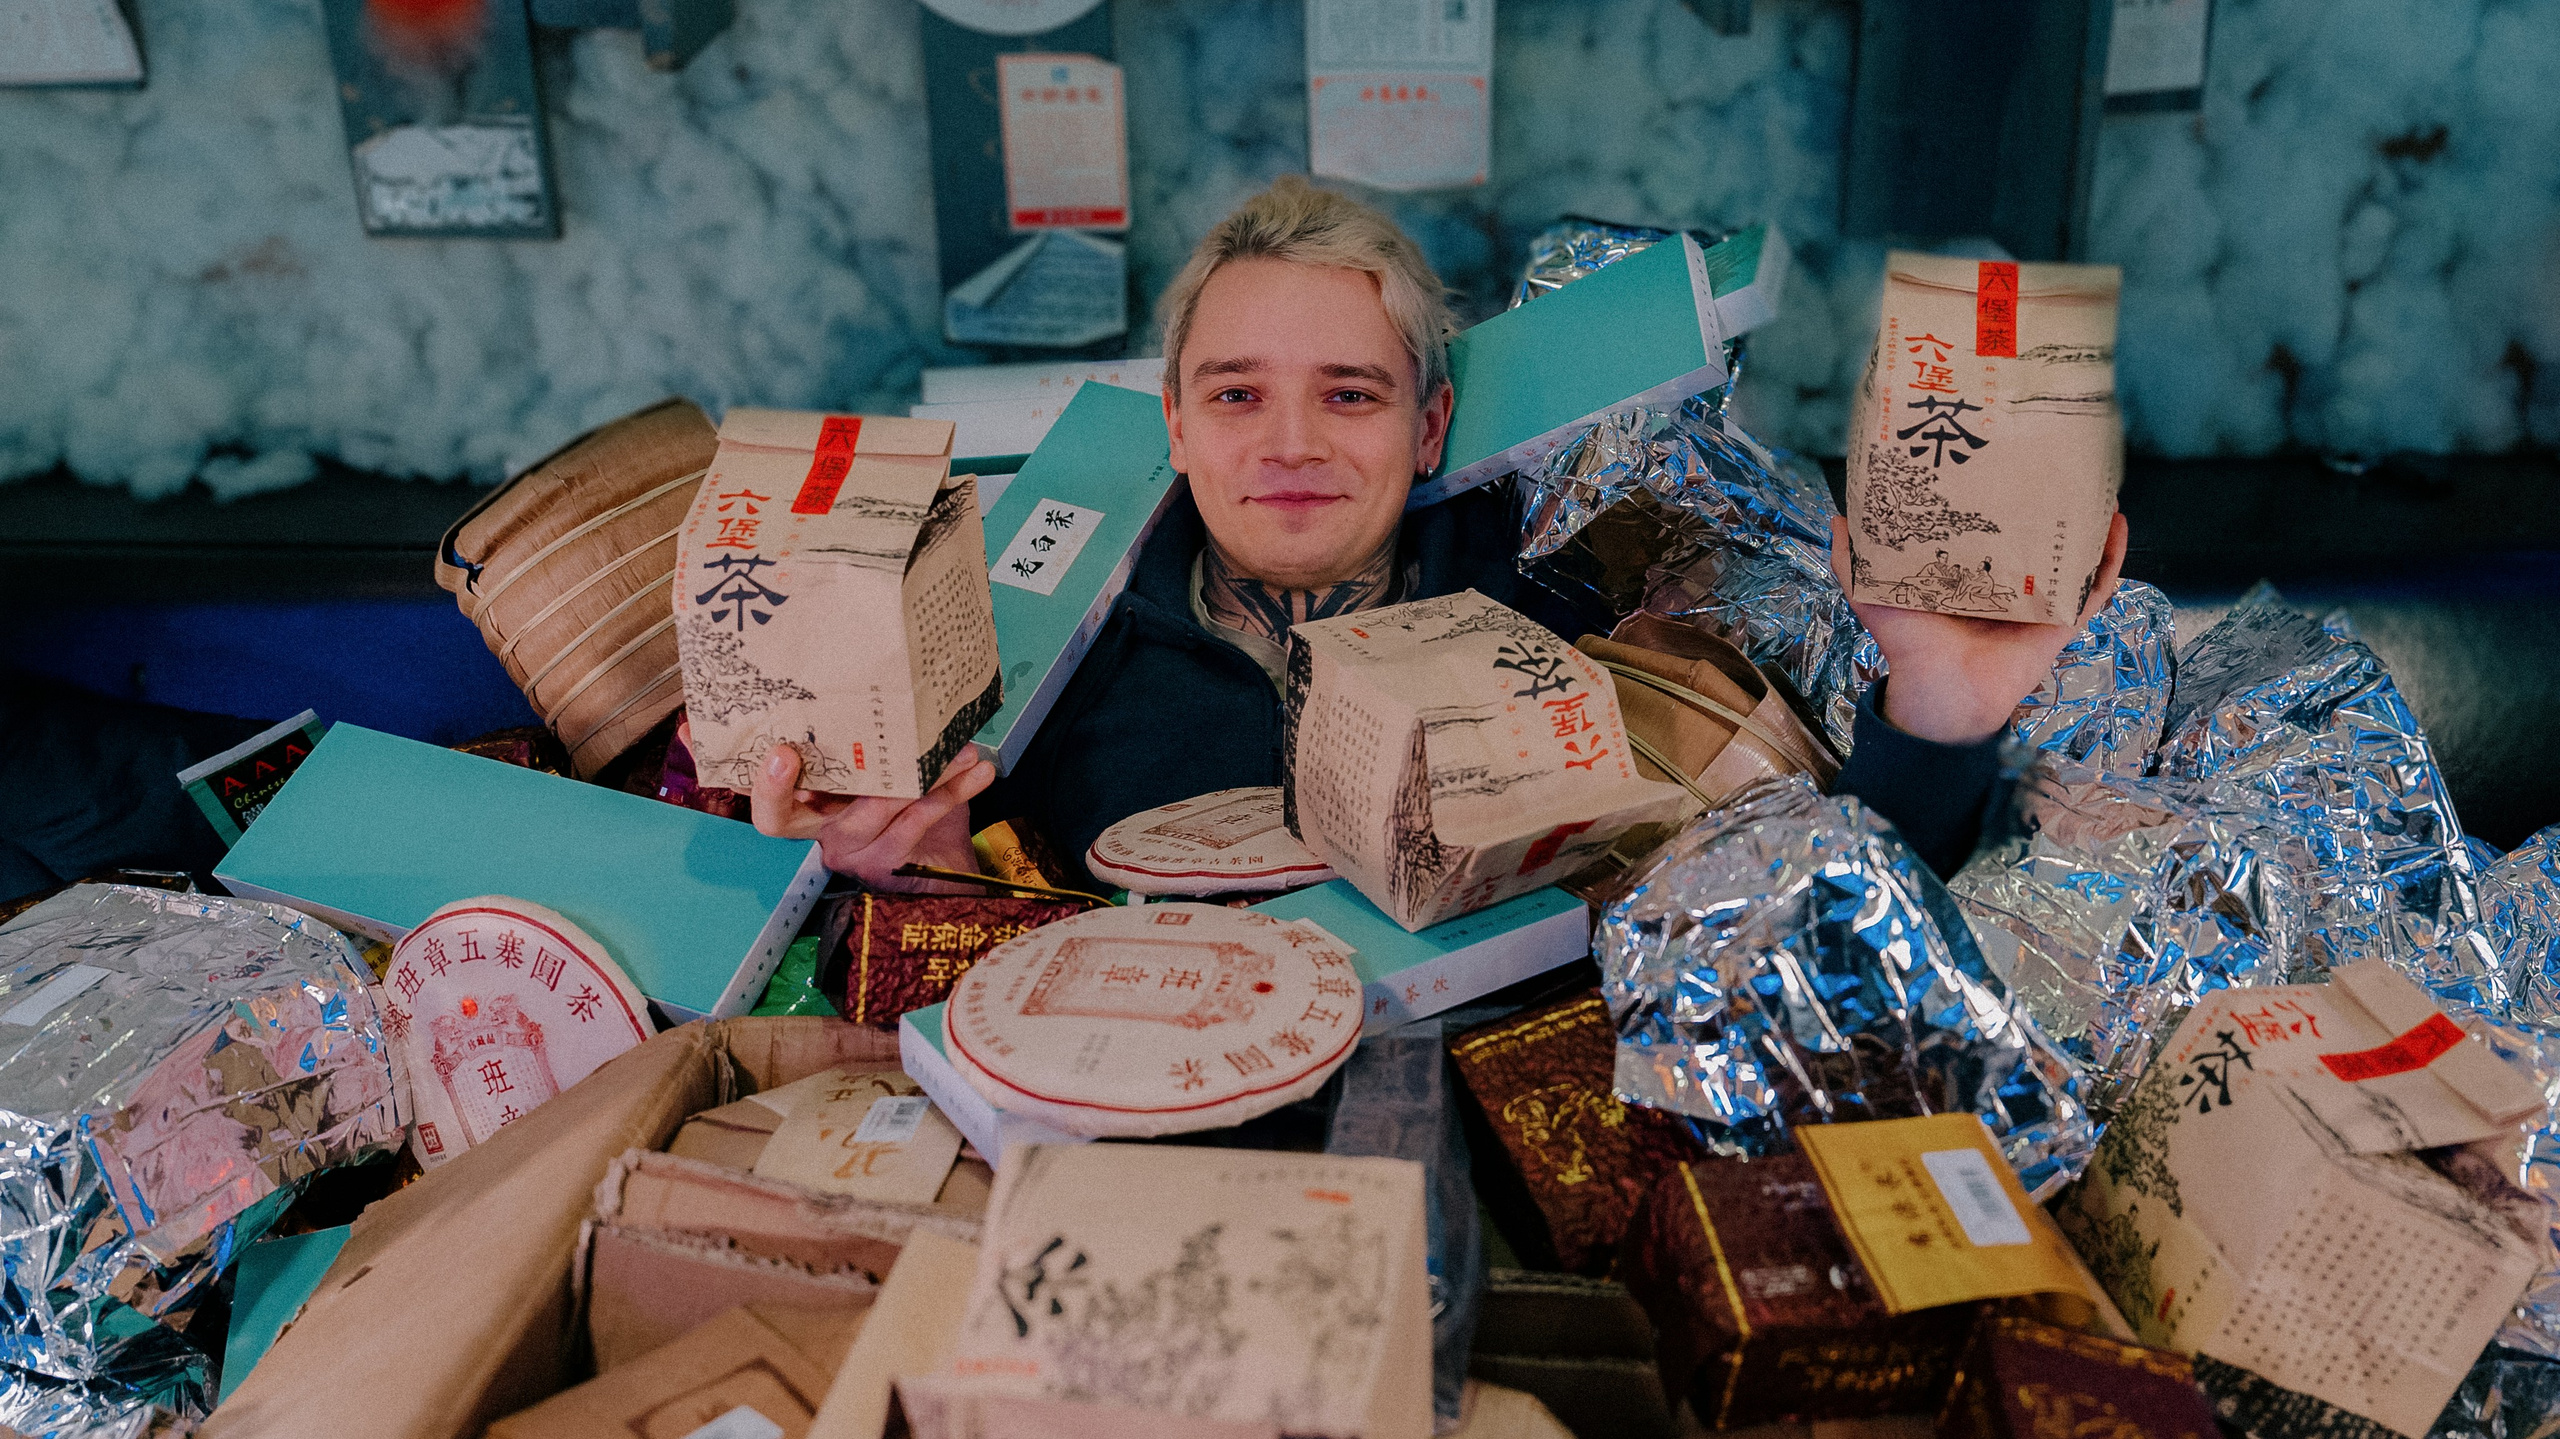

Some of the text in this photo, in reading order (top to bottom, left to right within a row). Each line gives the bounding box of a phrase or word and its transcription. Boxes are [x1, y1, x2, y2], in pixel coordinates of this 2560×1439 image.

[1980, 266, 2013, 352] 六堡茶
[1896, 333, 1990, 468] 六堡茶
[804, 422, 855, 508] 六堡茶
[696, 488, 789, 632] 六堡茶
[1010, 509, 1076, 581] 老白茶
[1492, 640, 1611, 772] 六堡茶
[2178, 998, 2324, 1114] 六堡茶
